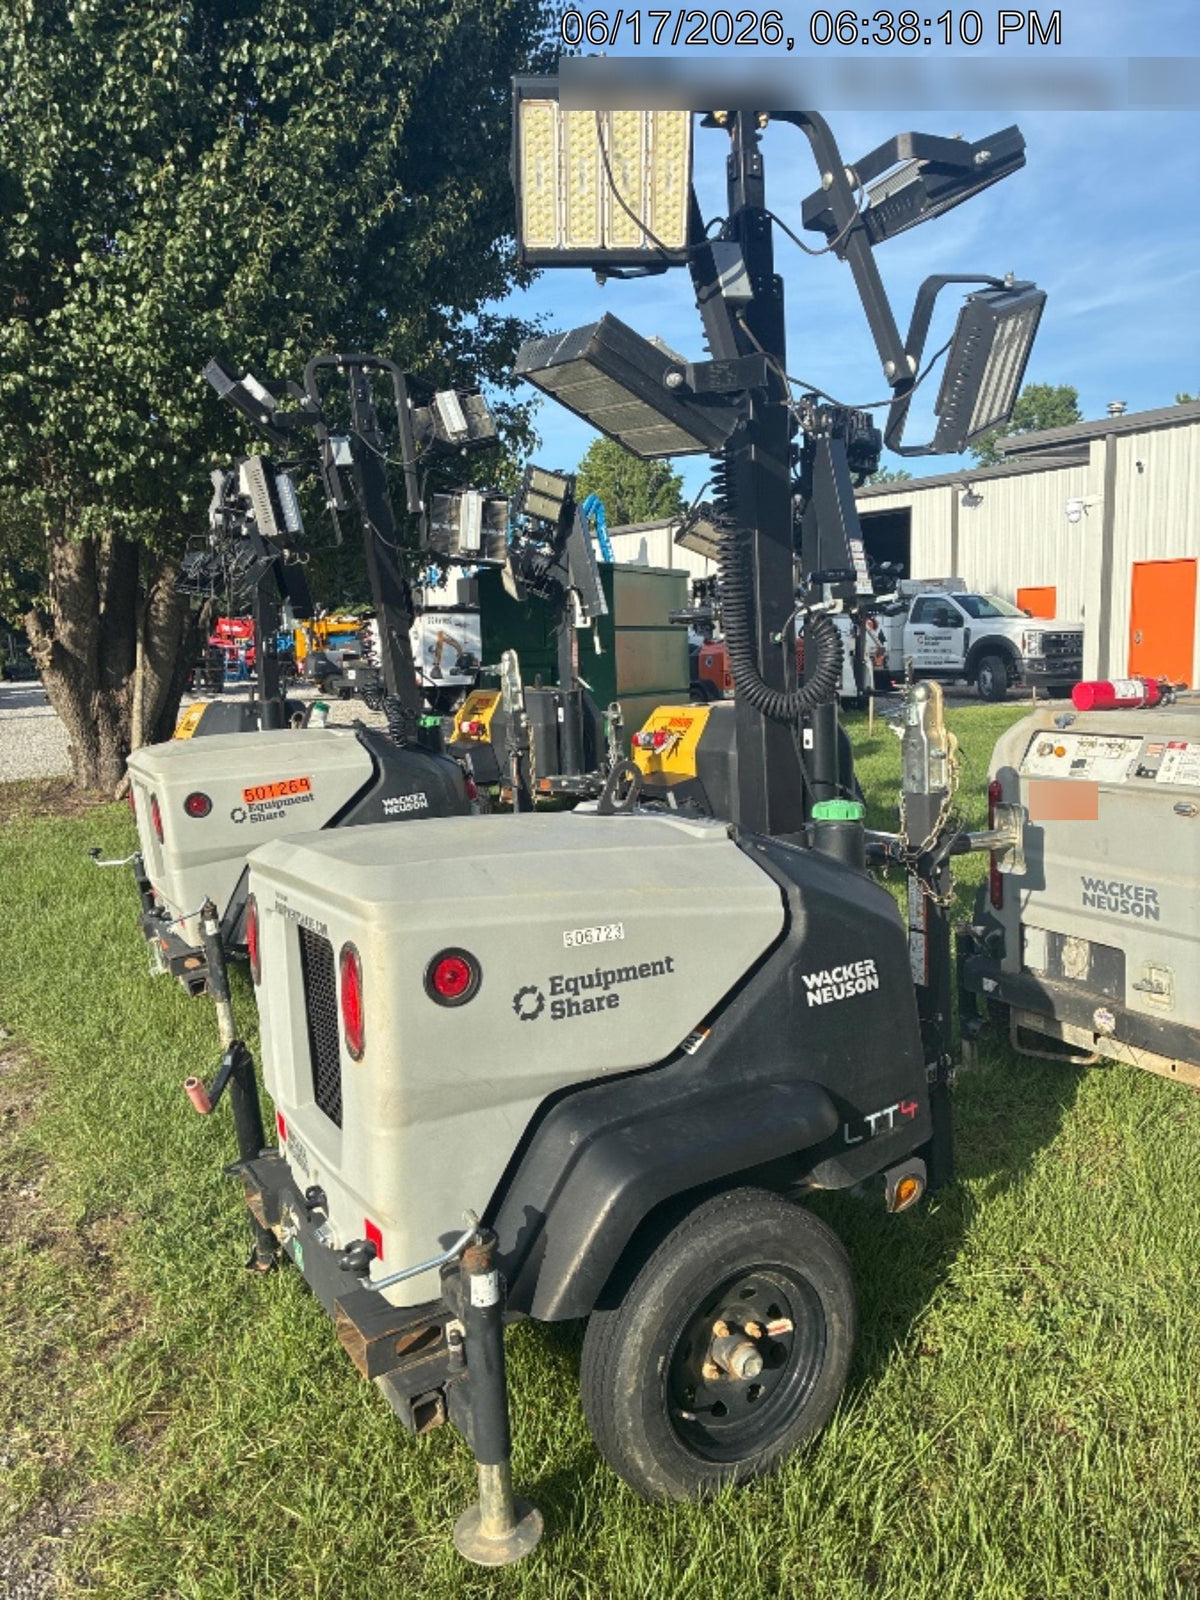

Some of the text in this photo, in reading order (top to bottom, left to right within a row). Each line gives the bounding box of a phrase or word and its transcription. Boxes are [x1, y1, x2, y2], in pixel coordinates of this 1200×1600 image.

[243, 778, 311, 803] 501269
[247, 793, 315, 814] Equipment
[382, 792, 426, 807] WACKER
[249, 808, 286, 824] Share
[384, 801, 428, 815] NEUSON
[1080, 876, 1159, 905] WACKER
[1082, 891, 1160, 921] NEUSON
[564, 925, 623, 947] 506723
[549, 955, 675, 997] Equipment
[801, 959, 877, 989] WACKER
[806, 973, 880, 1007] NEUSON
[550, 992, 620, 1021] Share
